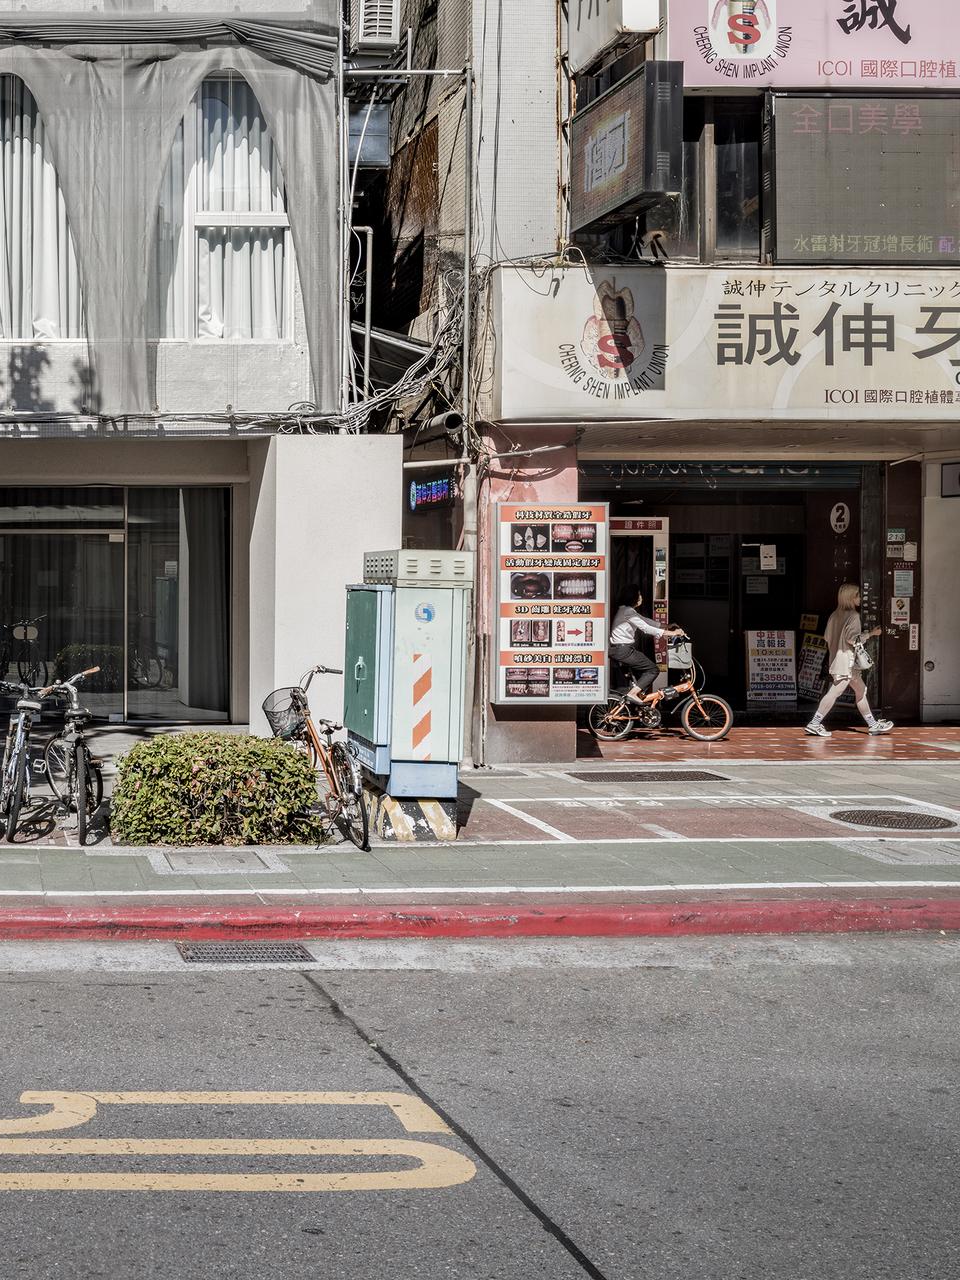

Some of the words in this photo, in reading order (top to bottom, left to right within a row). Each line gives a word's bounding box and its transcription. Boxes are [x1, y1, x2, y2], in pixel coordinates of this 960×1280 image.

[693, 25, 718, 65] CHERNG
[714, 58, 740, 78] SHEN
[743, 54, 779, 79] IMPLANT
[773, 26, 792, 58] UNION
[818, 60, 852, 77] ICOI
[791, 103, 924, 135] 全口美學
[793, 234, 934, 253] 水雷射牙冠增長術
[558, 343, 586, 383] CHERNG
[582, 376, 611, 399] SHEN
[614, 371, 655, 400] IMPLANT
[647, 344, 670, 375] UNION
[824, 389, 858, 404] ICOI
[836, 505, 845, 523] 2
[515, 606, 529, 614] 3D
